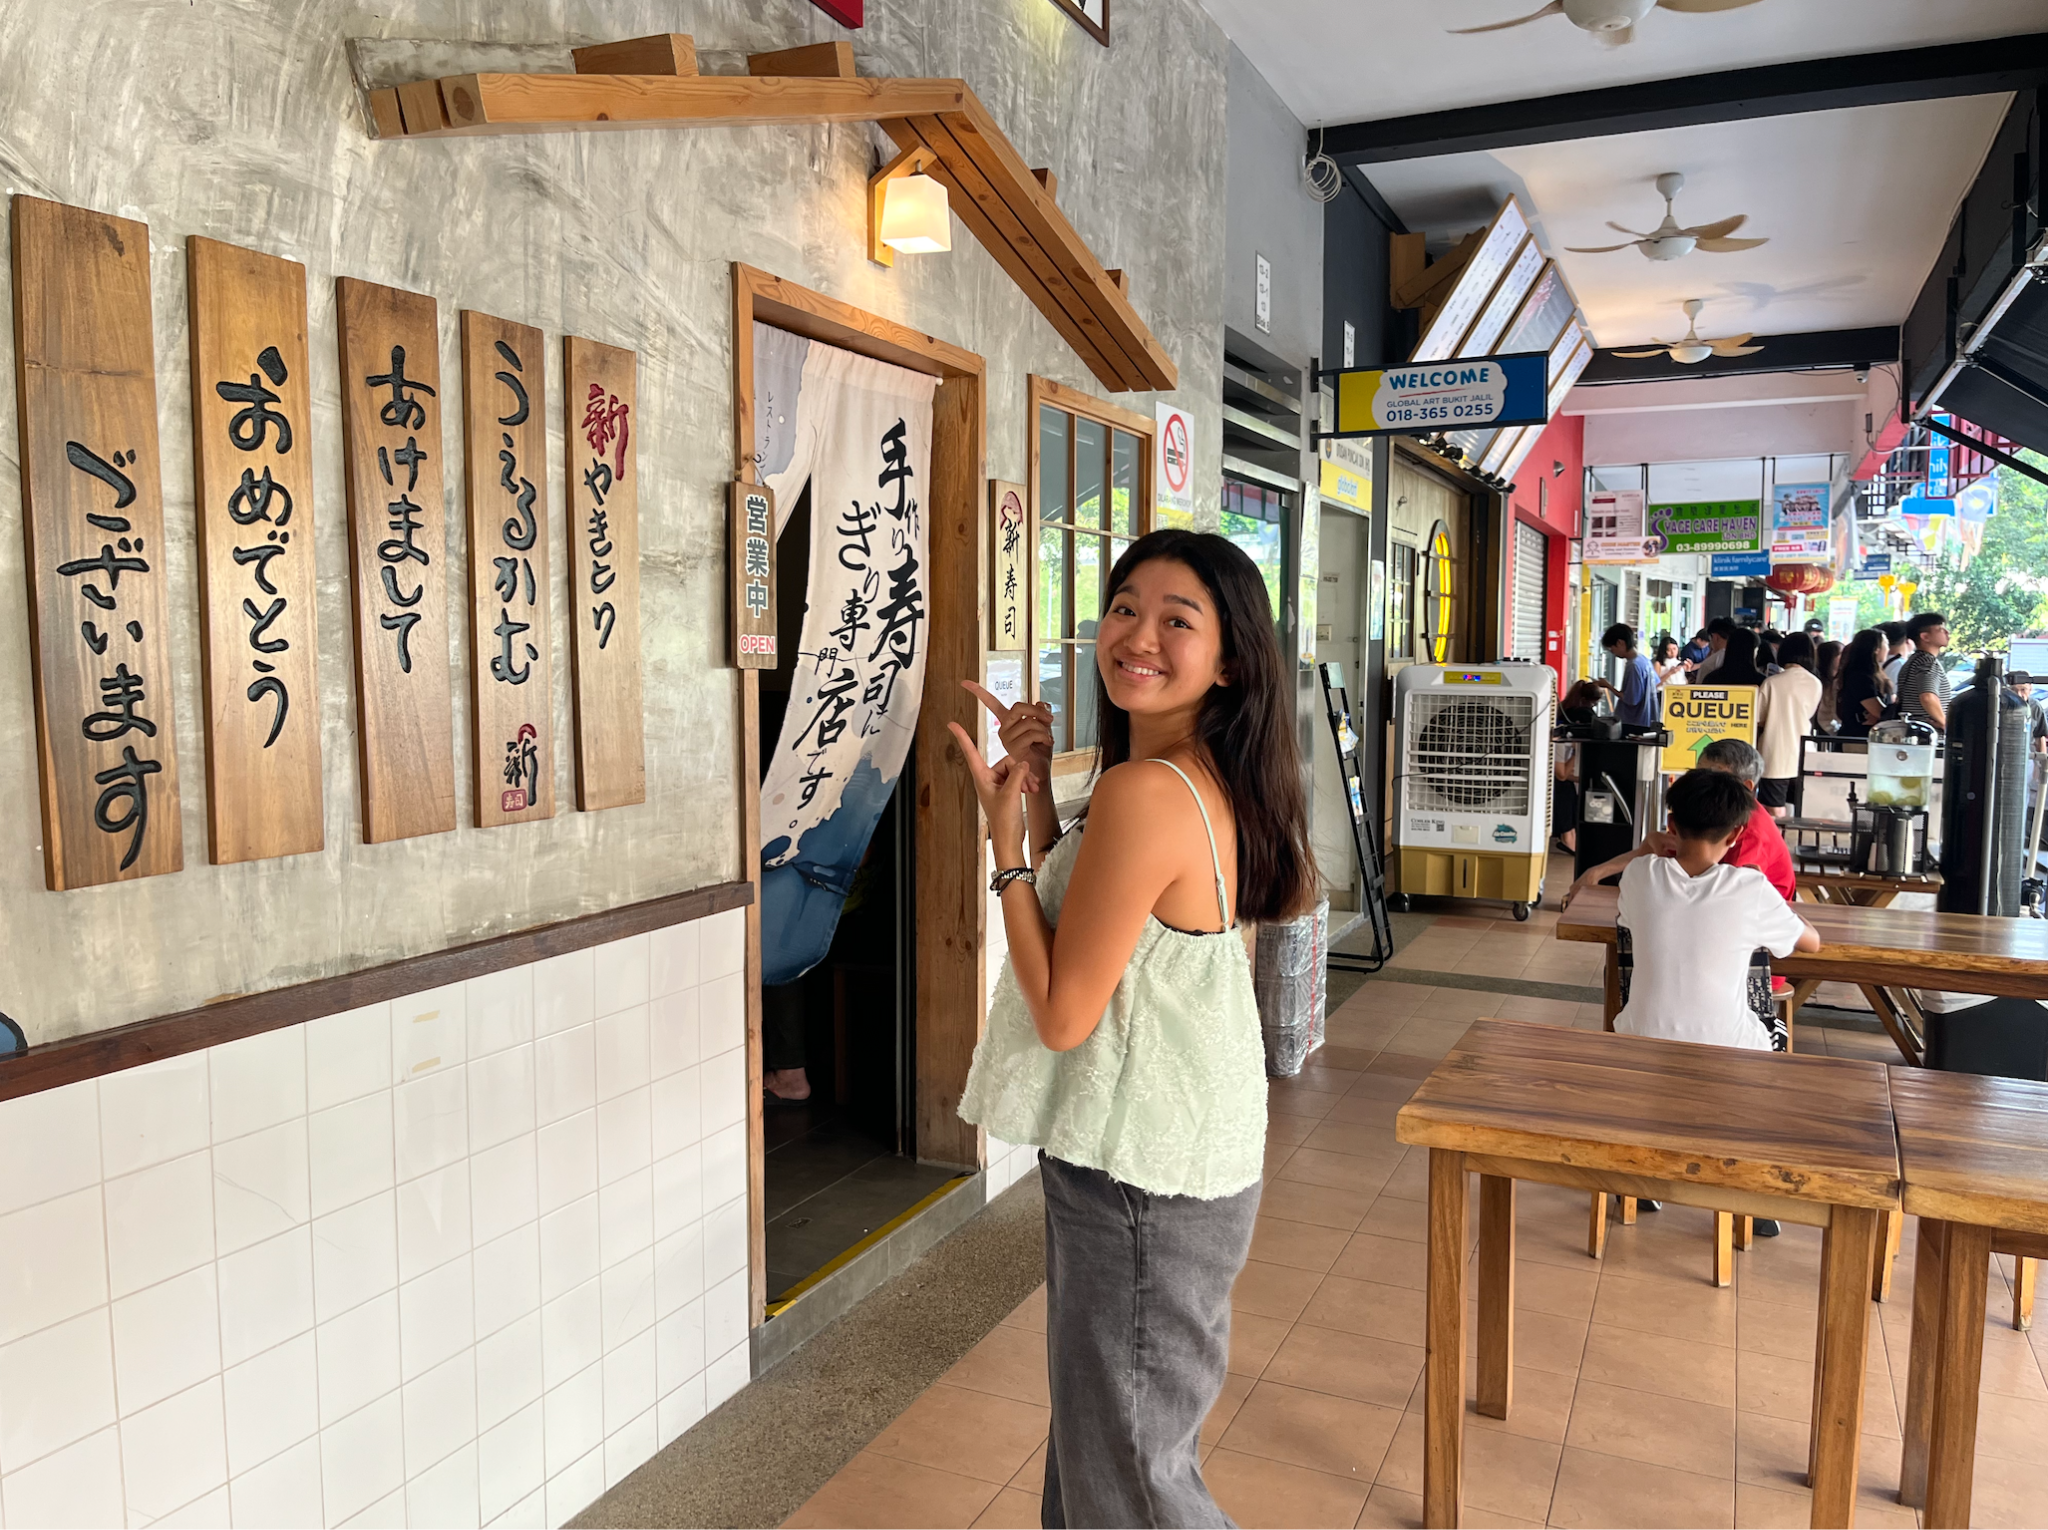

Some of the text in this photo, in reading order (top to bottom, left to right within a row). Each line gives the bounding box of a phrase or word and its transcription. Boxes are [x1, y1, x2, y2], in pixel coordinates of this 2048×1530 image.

[1389, 367, 1490, 391] WELCOME
[1386, 393, 1494, 409] GLOBAL ART BUKIT JALIL
[1386, 403, 1494, 422] 018-365 0255
[366, 345, 438, 674] あけまして
[490, 340, 539, 686] うえるかむ
[581, 383, 630, 650] 新やきとり
[1693, 518, 1720, 534] CARE
[1721, 516, 1758, 531] HAVEN
[1722, 531, 1757, 541] SDN BHD
[216, 346, 293, 749] おめでとう
[1676, 541, 1750, 552] 03-89990698
[744, 494, 770, 619] 営業中
[1713, 555, 1731, 564] klinik
[740, 634, 776, 654] OPEN
[56, 440, 162, 872] ございます
[995, 680, 1013, 690] QUEUE
[1692, 691, 1725, 699] PLEASE
[1668, 701, 1749, 719] QUEUE
